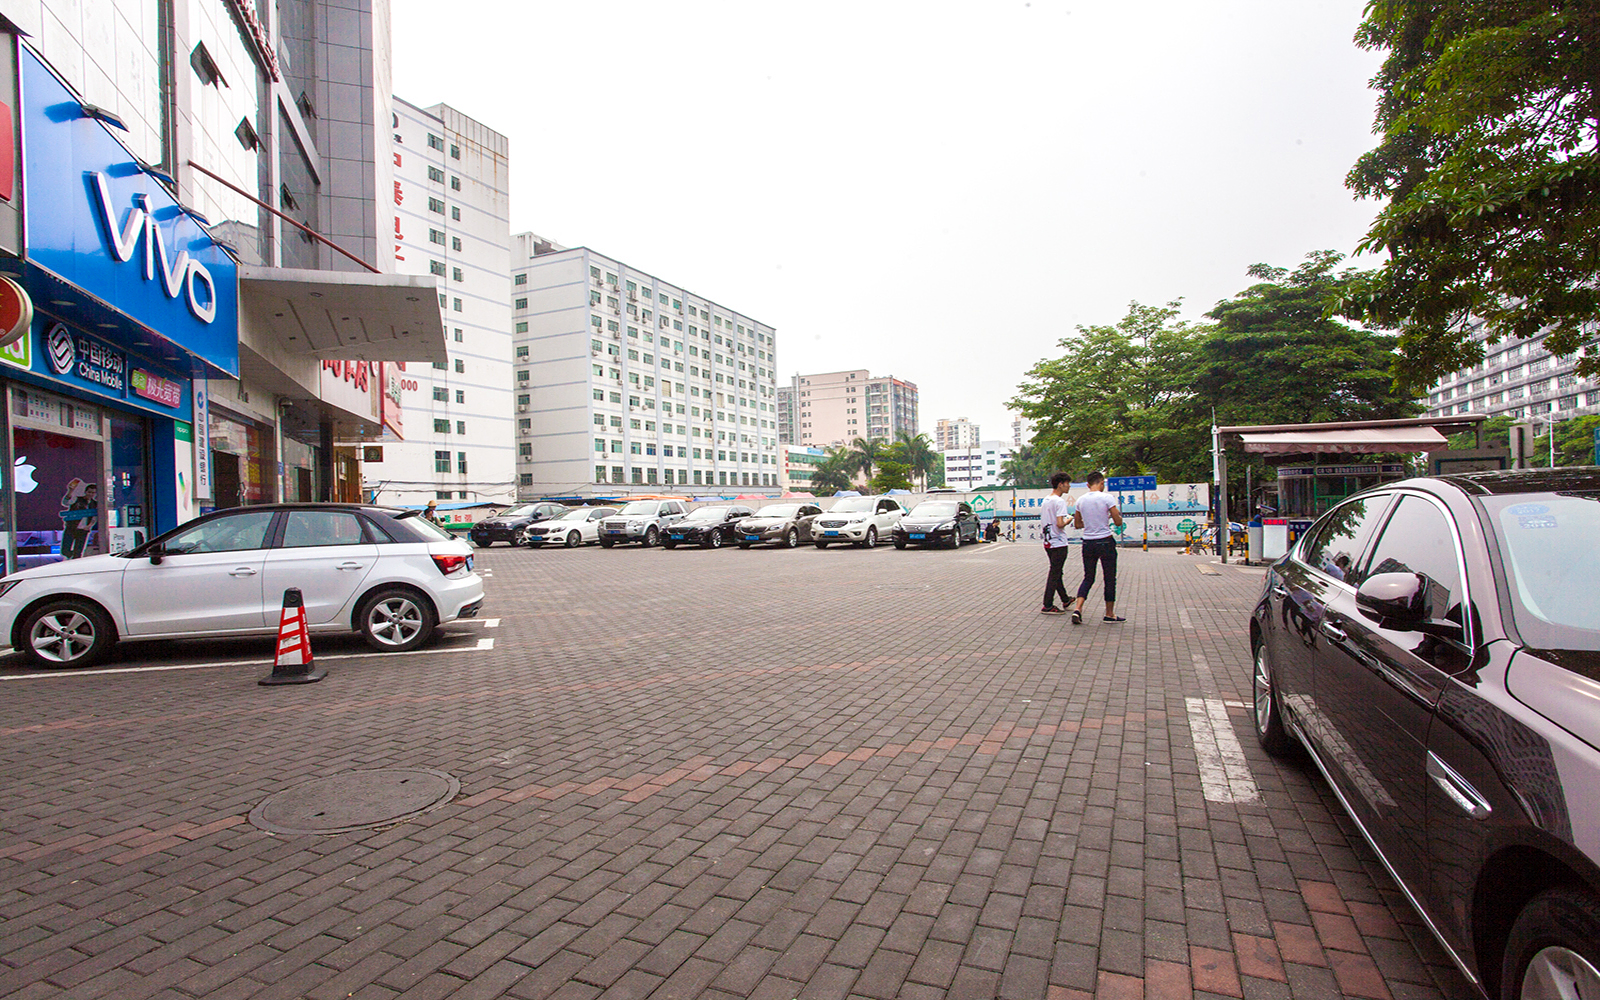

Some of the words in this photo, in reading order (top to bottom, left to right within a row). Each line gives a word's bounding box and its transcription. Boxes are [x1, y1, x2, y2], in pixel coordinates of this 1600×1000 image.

[82, 170, 217, 324] vivo
[79, 338, 123, 374] 中国移动
[79, 361, 101, 382] China
[100, 369, 123, 390] Mobile
